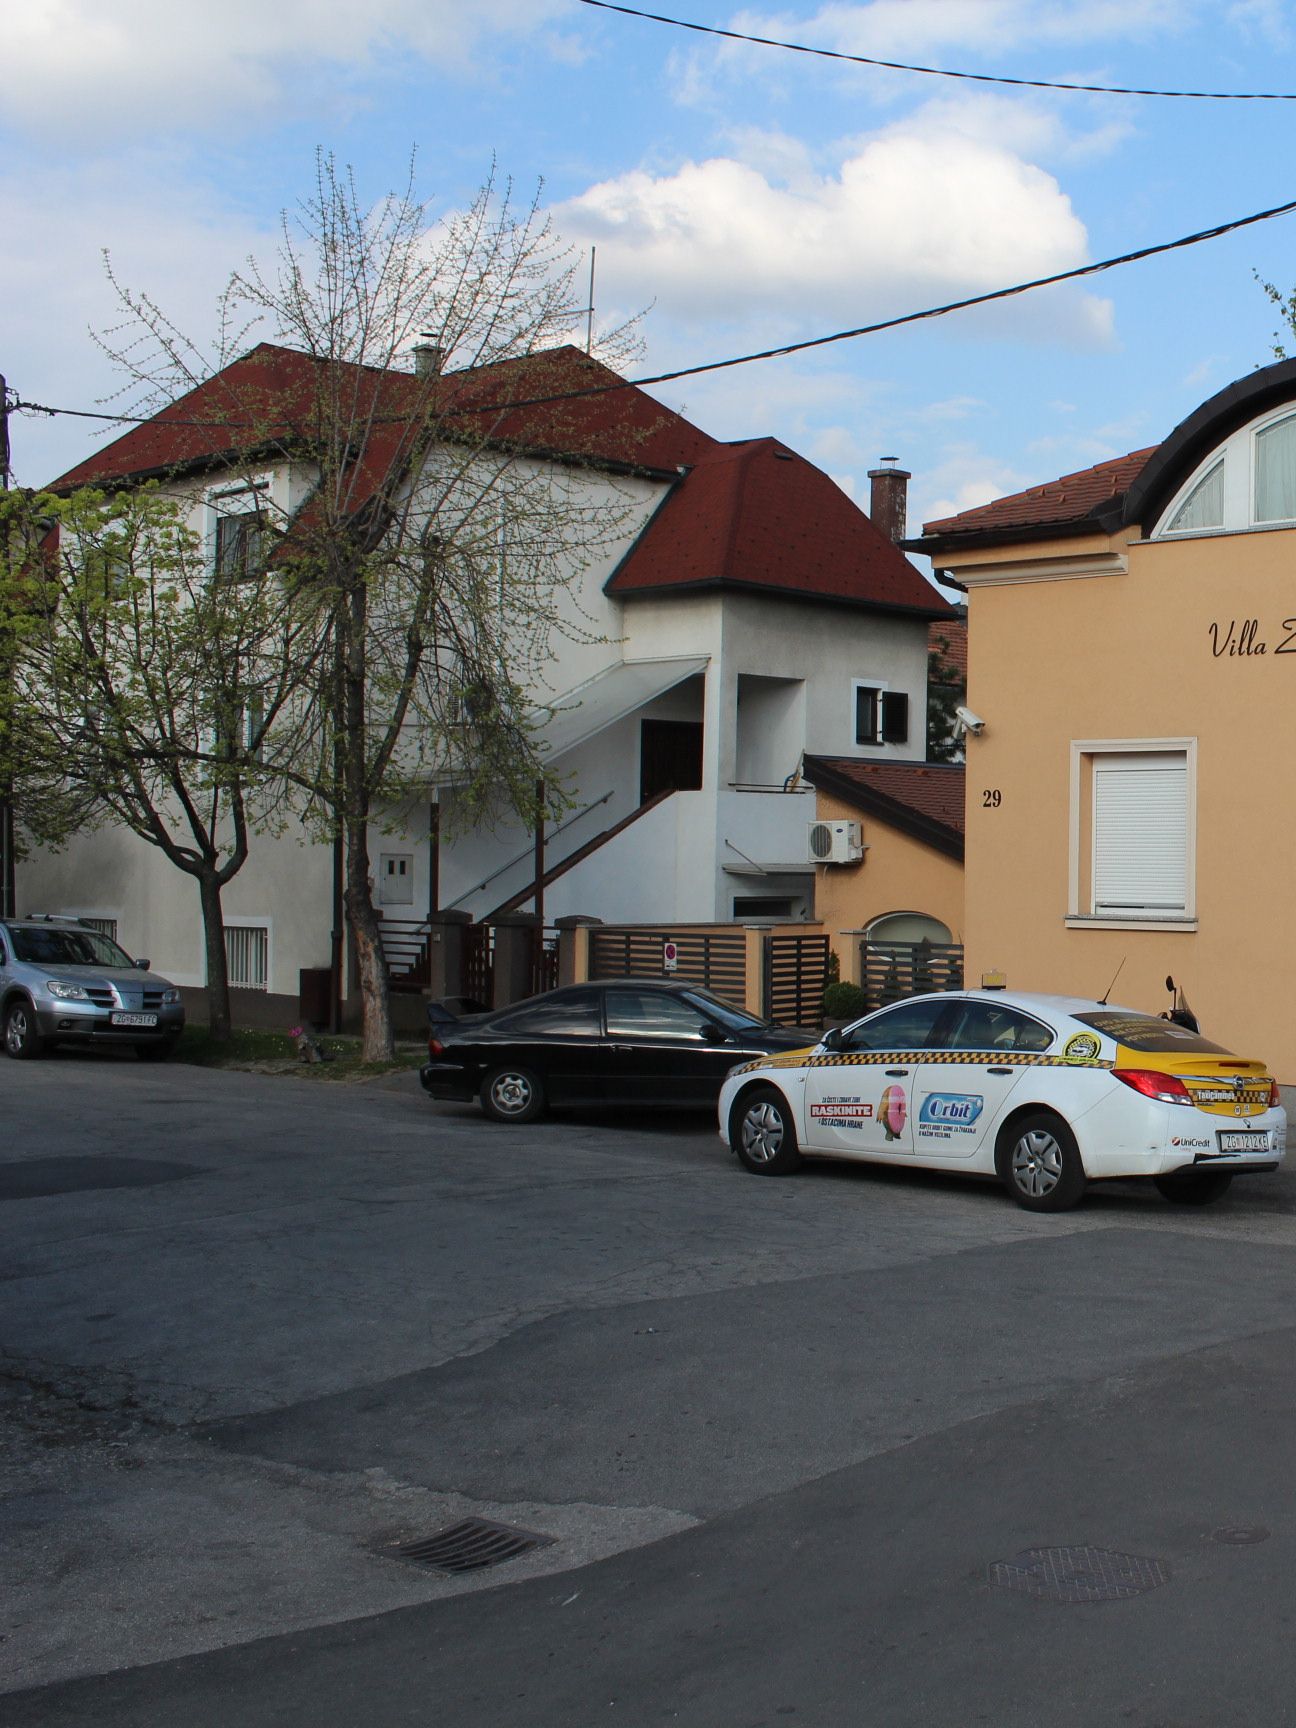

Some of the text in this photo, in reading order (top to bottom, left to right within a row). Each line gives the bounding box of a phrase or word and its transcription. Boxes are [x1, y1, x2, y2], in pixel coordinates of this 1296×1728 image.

[1208, 618, 1266, 657] Villa
[982, 789, 1002, 808] 29
[811, 1105, 871, 1116] RASKINITE
[929, 1099, 971, 1118] Orbit
[1180, 1137, 1210, 1148] UniCredit
